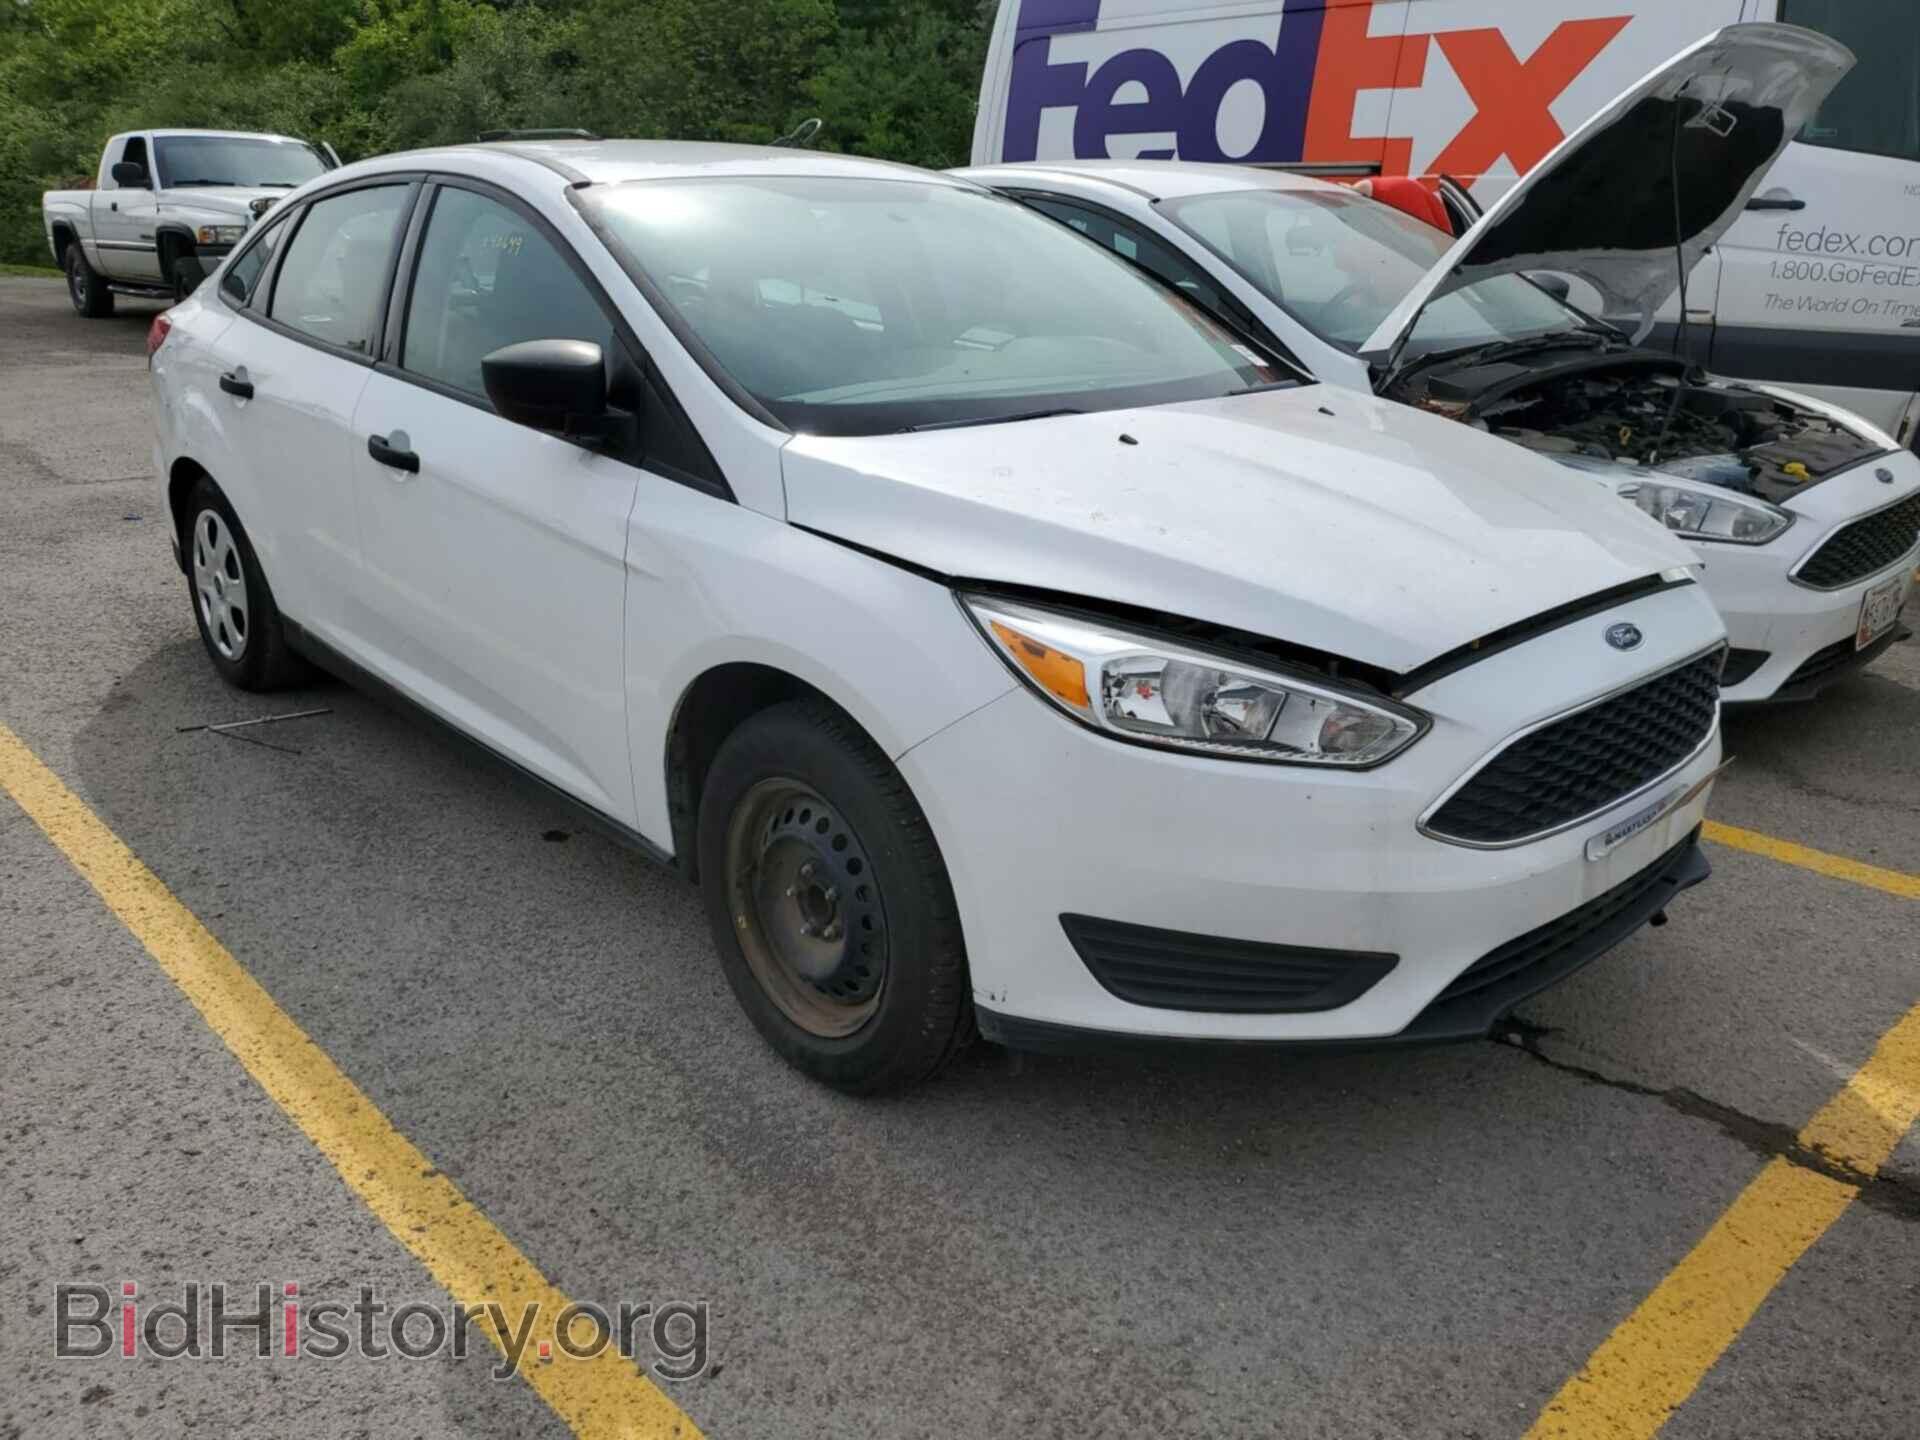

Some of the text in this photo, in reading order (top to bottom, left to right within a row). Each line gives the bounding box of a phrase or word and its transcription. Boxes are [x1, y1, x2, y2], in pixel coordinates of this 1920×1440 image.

[1002, 0, 1635, 194] FedEx
[1765, 293, 1794, 311] The
[1798, 295, 1849, 313] World
[1851, 297, 1878, 315] On
